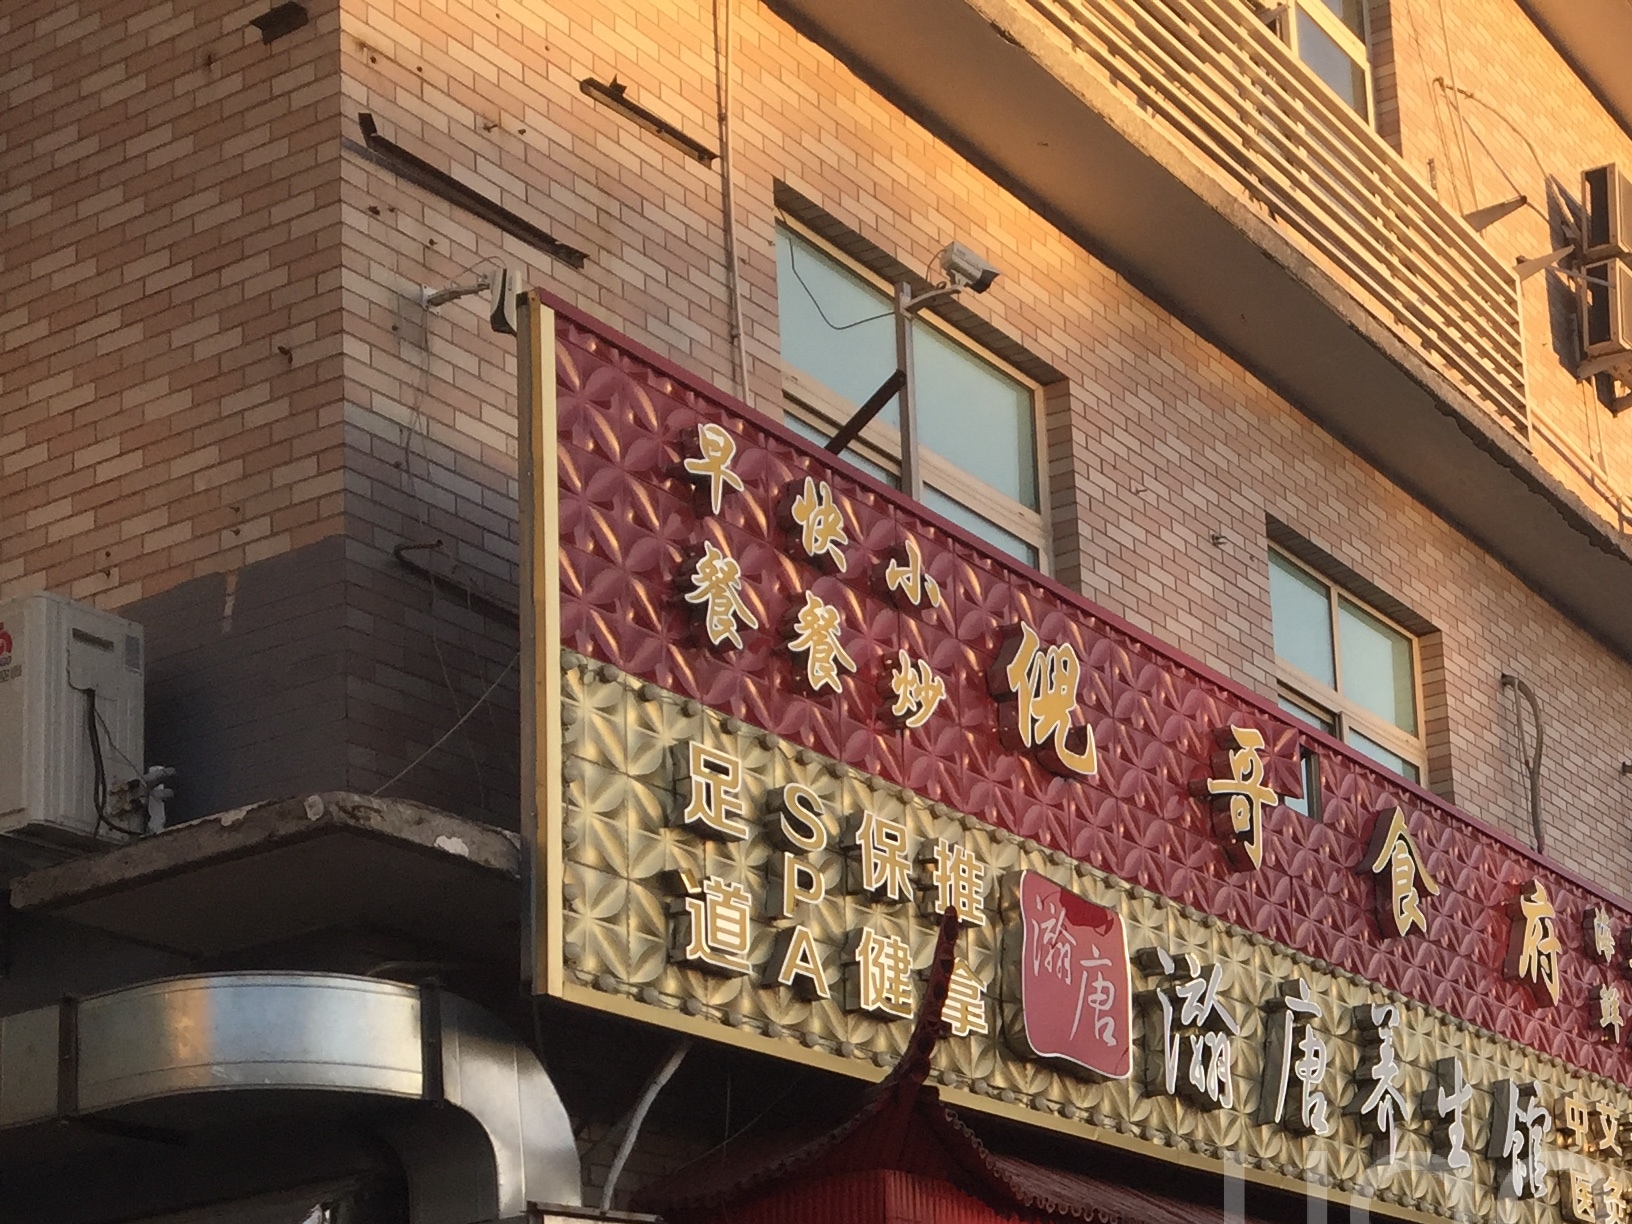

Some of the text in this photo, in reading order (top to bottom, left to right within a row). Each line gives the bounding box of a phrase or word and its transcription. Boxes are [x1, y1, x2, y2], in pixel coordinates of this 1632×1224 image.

[684, 423, 758, 649] 早餐
[788, 474, 856, 693] 快餐
[886, 538, 945, 728] 小炒
[684, 740, 751, 974] 足道
[779, 782, 830, 998] SPA
[855, 812, 914, 1019] 保健
[932, 838, 989, 1038] 推拿
